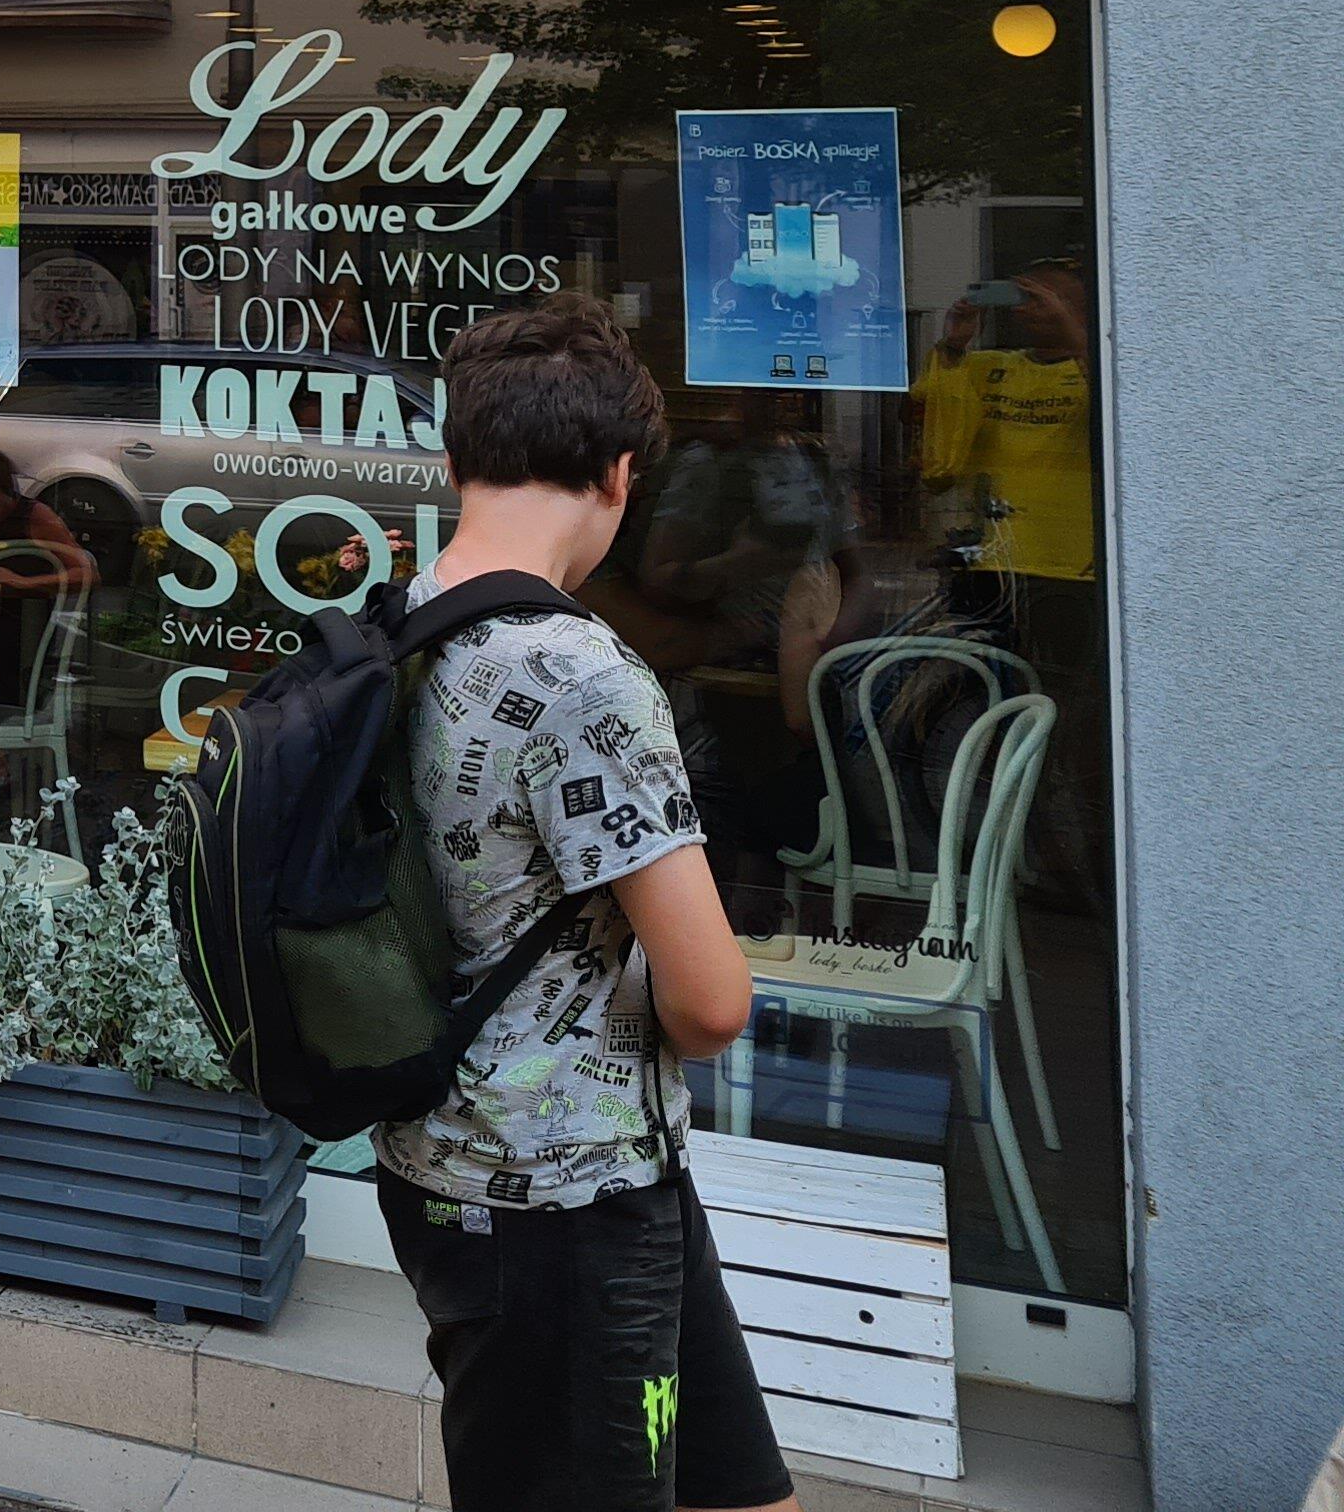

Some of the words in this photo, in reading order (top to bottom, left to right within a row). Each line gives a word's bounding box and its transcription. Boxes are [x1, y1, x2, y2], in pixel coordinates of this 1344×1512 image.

[150, 28, 568, 232] Lody
[212, 190, 407, 241] gałkowe
[157, 244, 278, 283] LODY
[296, 248, 363, 286] NA
[380, 251, 561, 294] WYNOS
[214, 295, 344, 356] LODY
[161, 613, 303, 655] świeżo
[472, 665, 499, 683] STAY
[494, 694, 522, 722] HAR
[508, 697, 537, 726] LEM
[579, 713, 619, 751] New
[596, 718, 642, 761] York
[456, 736, 492, 797] BRONX
[600, 803, 655, 850] 85
[609, 1023, 639, 1035] STAY
[826, 1006, 861, 1024] Like
[424, 1199, 461, 1215] SUPER
